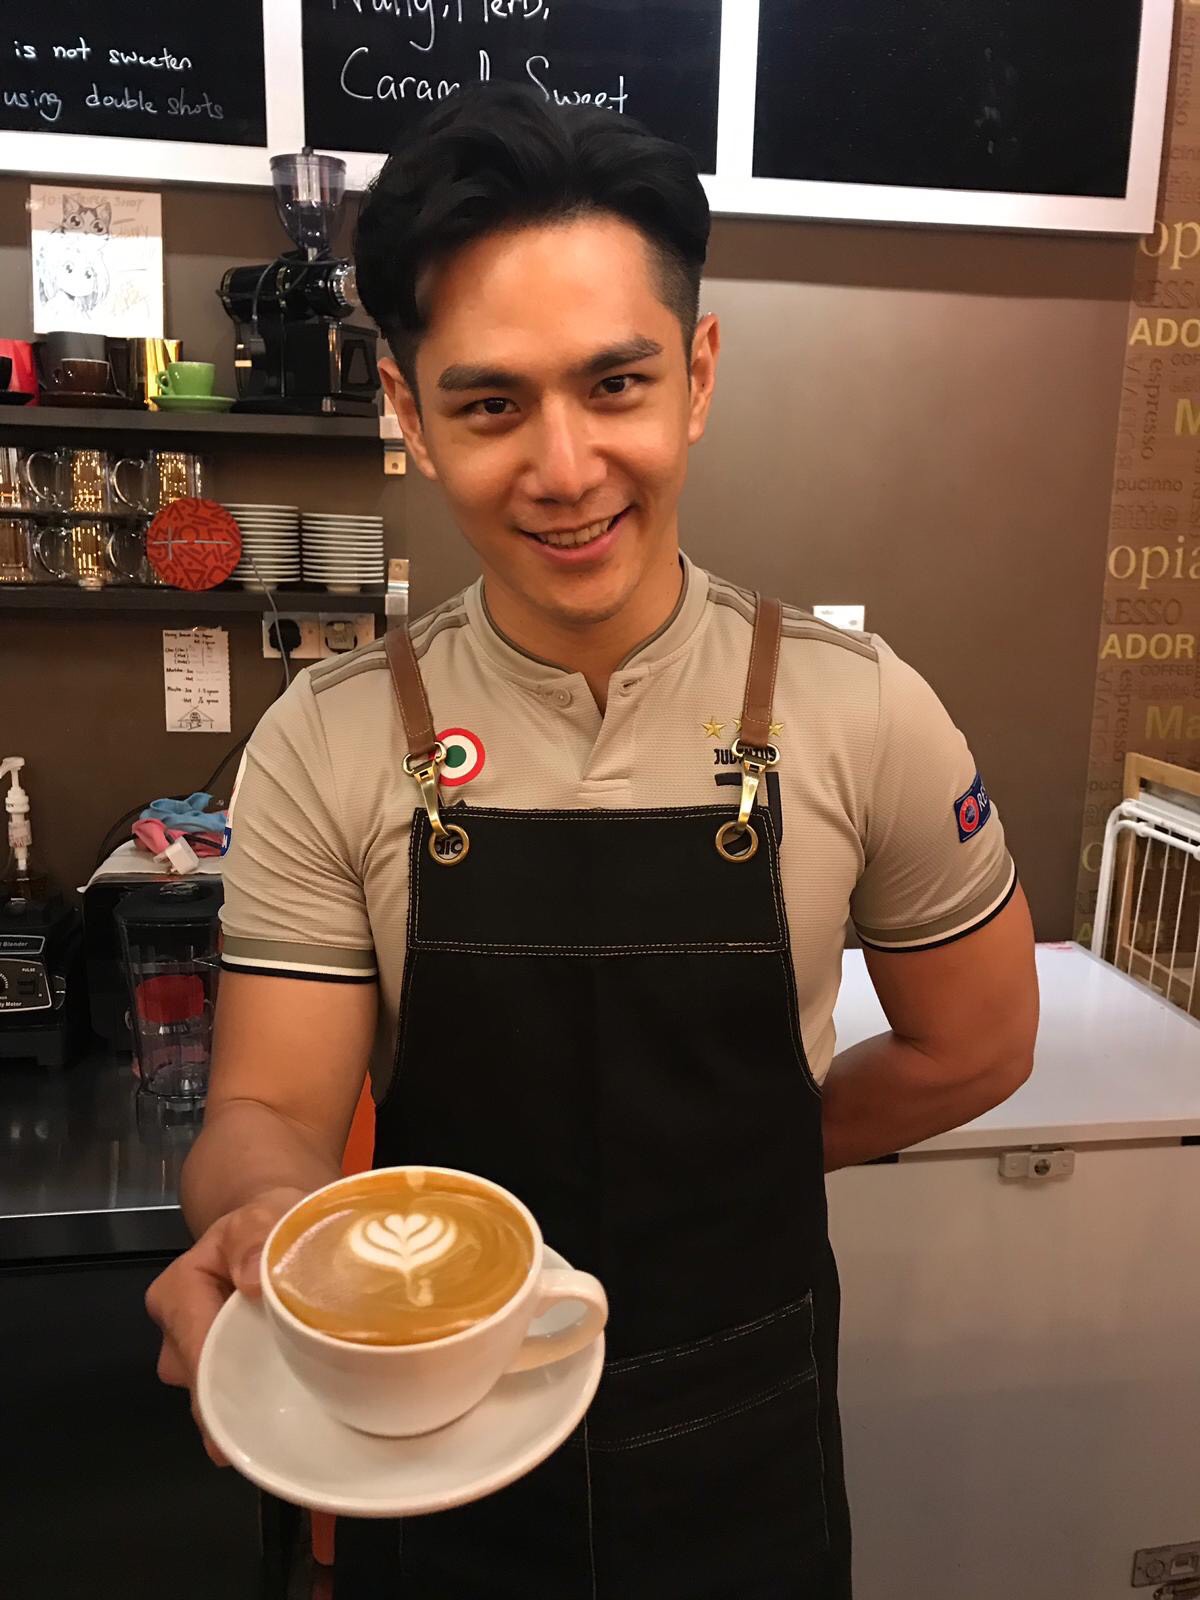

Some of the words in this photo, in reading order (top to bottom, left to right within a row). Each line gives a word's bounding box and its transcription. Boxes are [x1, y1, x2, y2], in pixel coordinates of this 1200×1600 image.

[14, 40, 37, 59] is
[53, 36, 91, 60] not
[109, 48, 192, 70] sweeten
[341, 47, 490, 100] Caraml
[4, 90, 62, 121] using
[85, 82, 158, 112] double
[1141, 357, 1163, 460] espresso
[1100, 632, 1195, 660] ADOR
